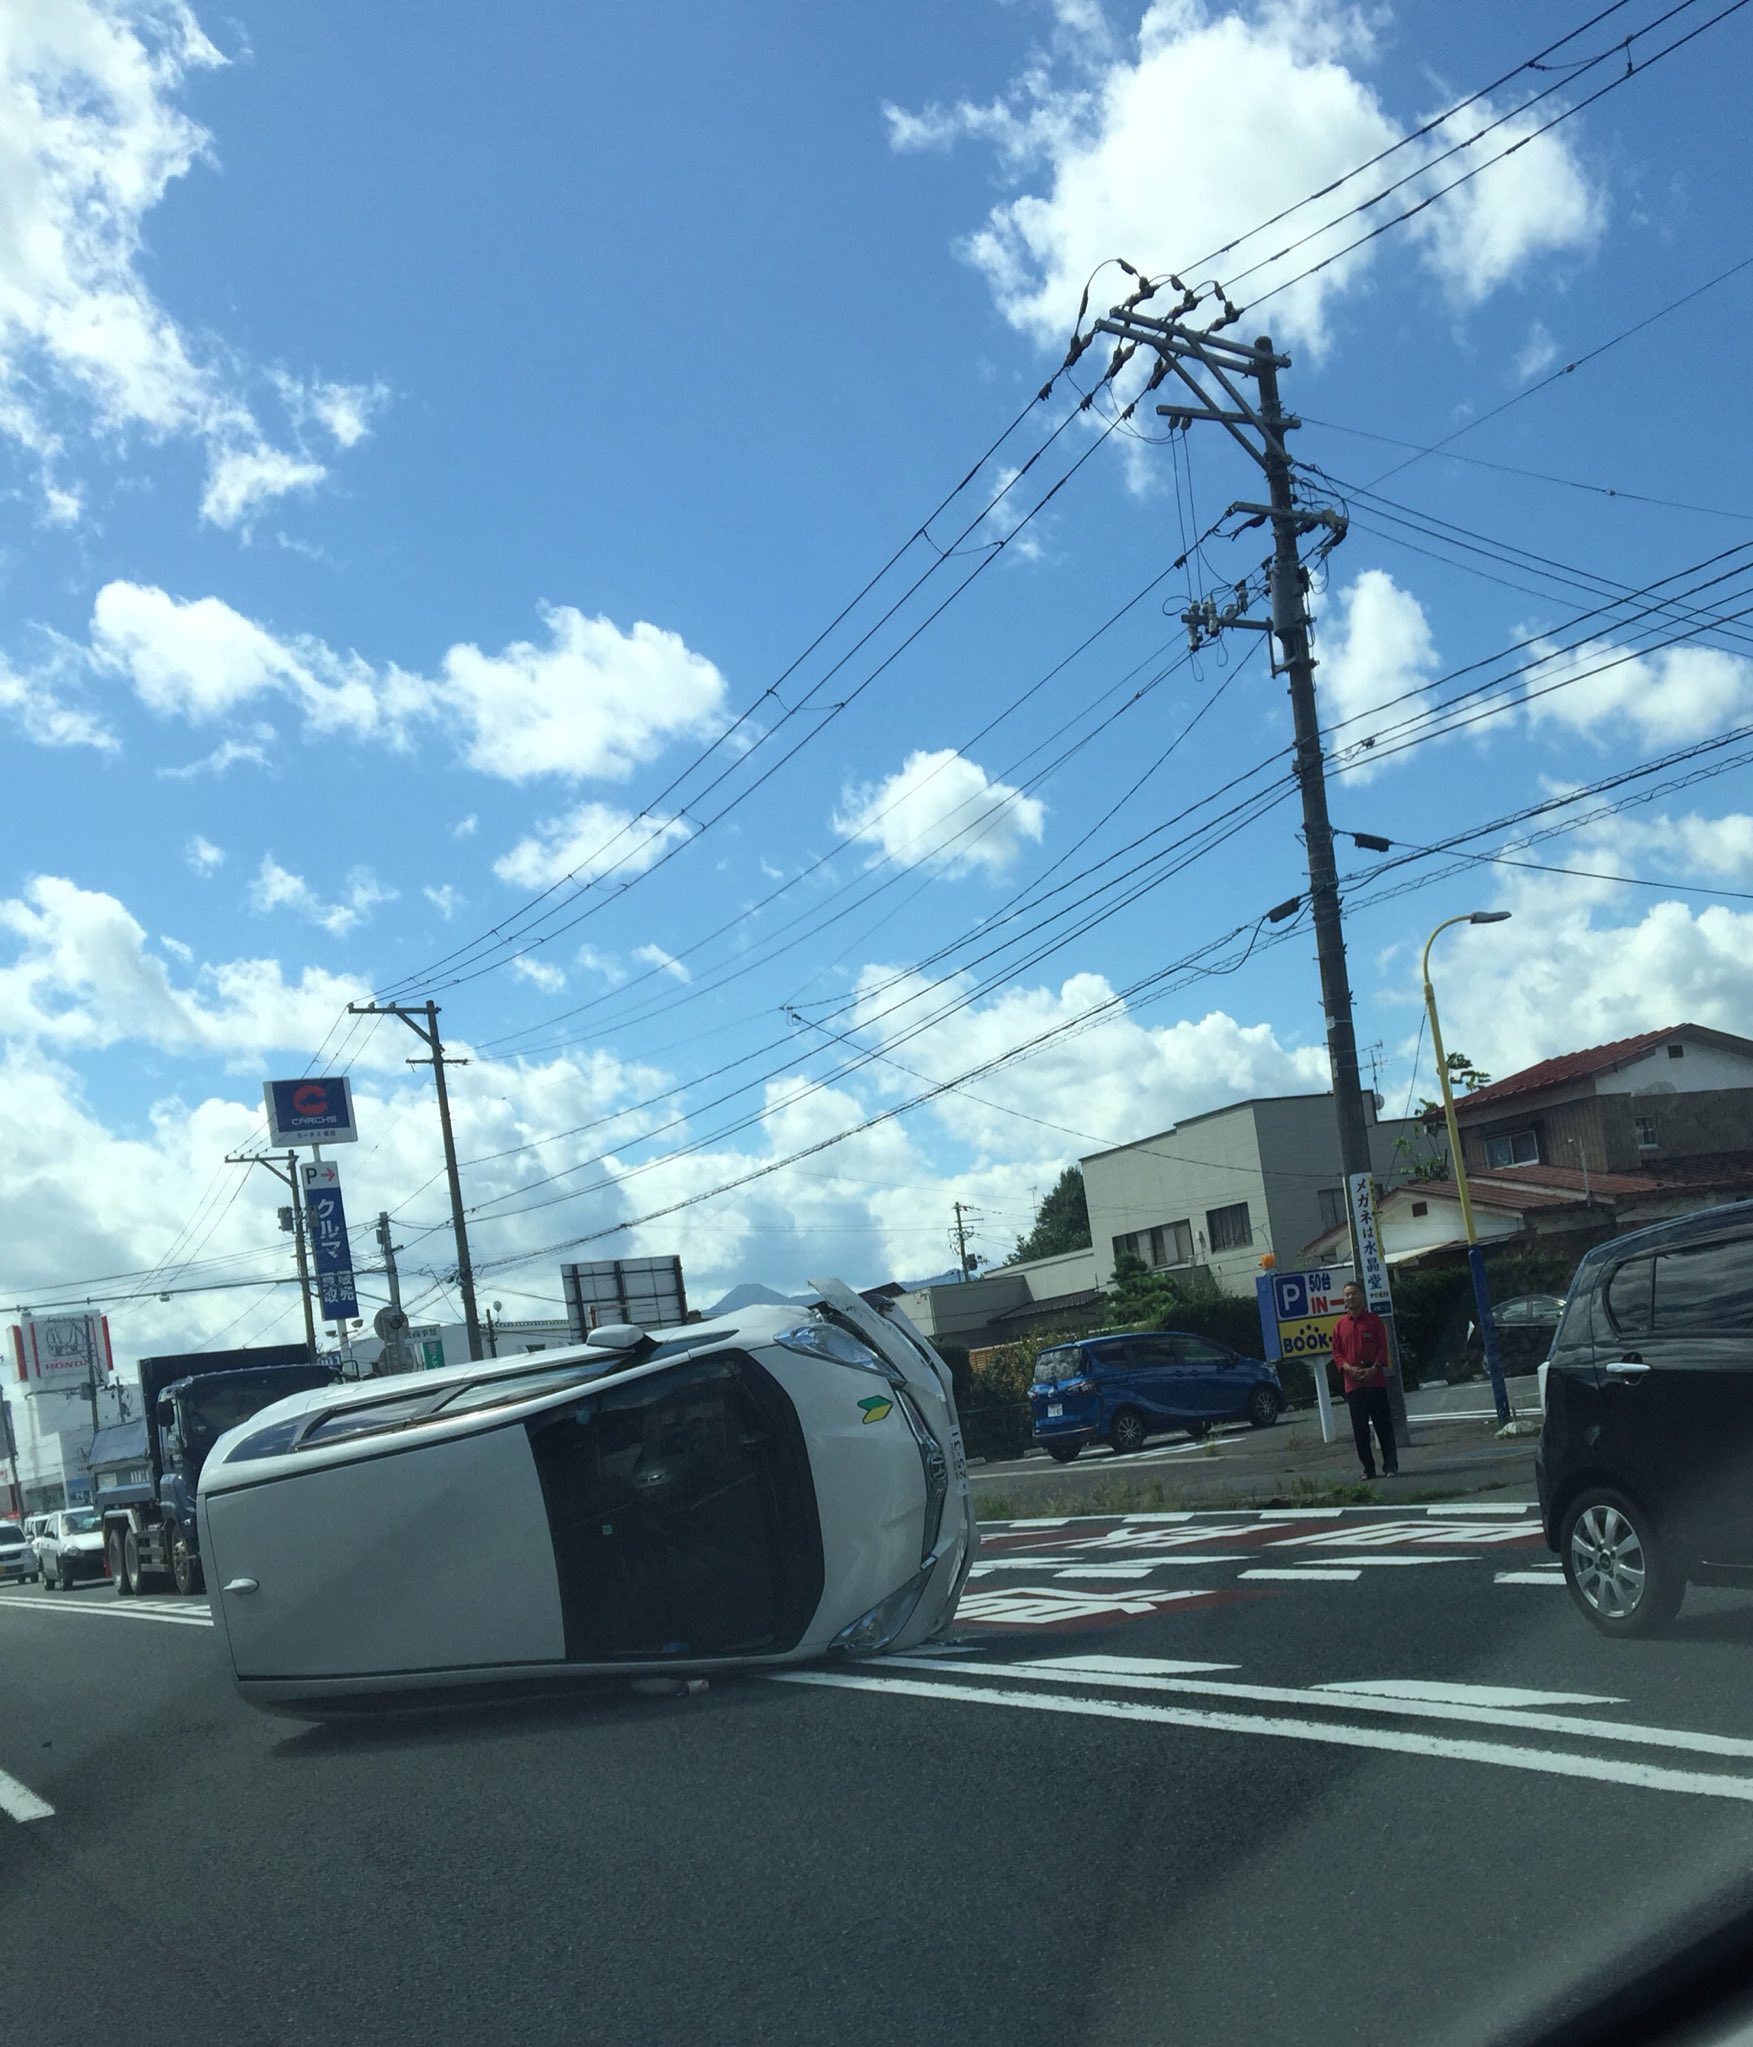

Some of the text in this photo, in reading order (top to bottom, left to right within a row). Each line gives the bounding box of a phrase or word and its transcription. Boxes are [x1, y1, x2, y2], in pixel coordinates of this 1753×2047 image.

[305, 1168, 318, 1185] P
[318, 1199, 341, 1259] クルマ
[1356, 1178, 1382, 1290] メガネは水晶堂
[1309, 1273, 1331, 1293] 50台
[1283, 1284, 1301, 1311] P
[1311, 1296, 1329, 1314] IN
